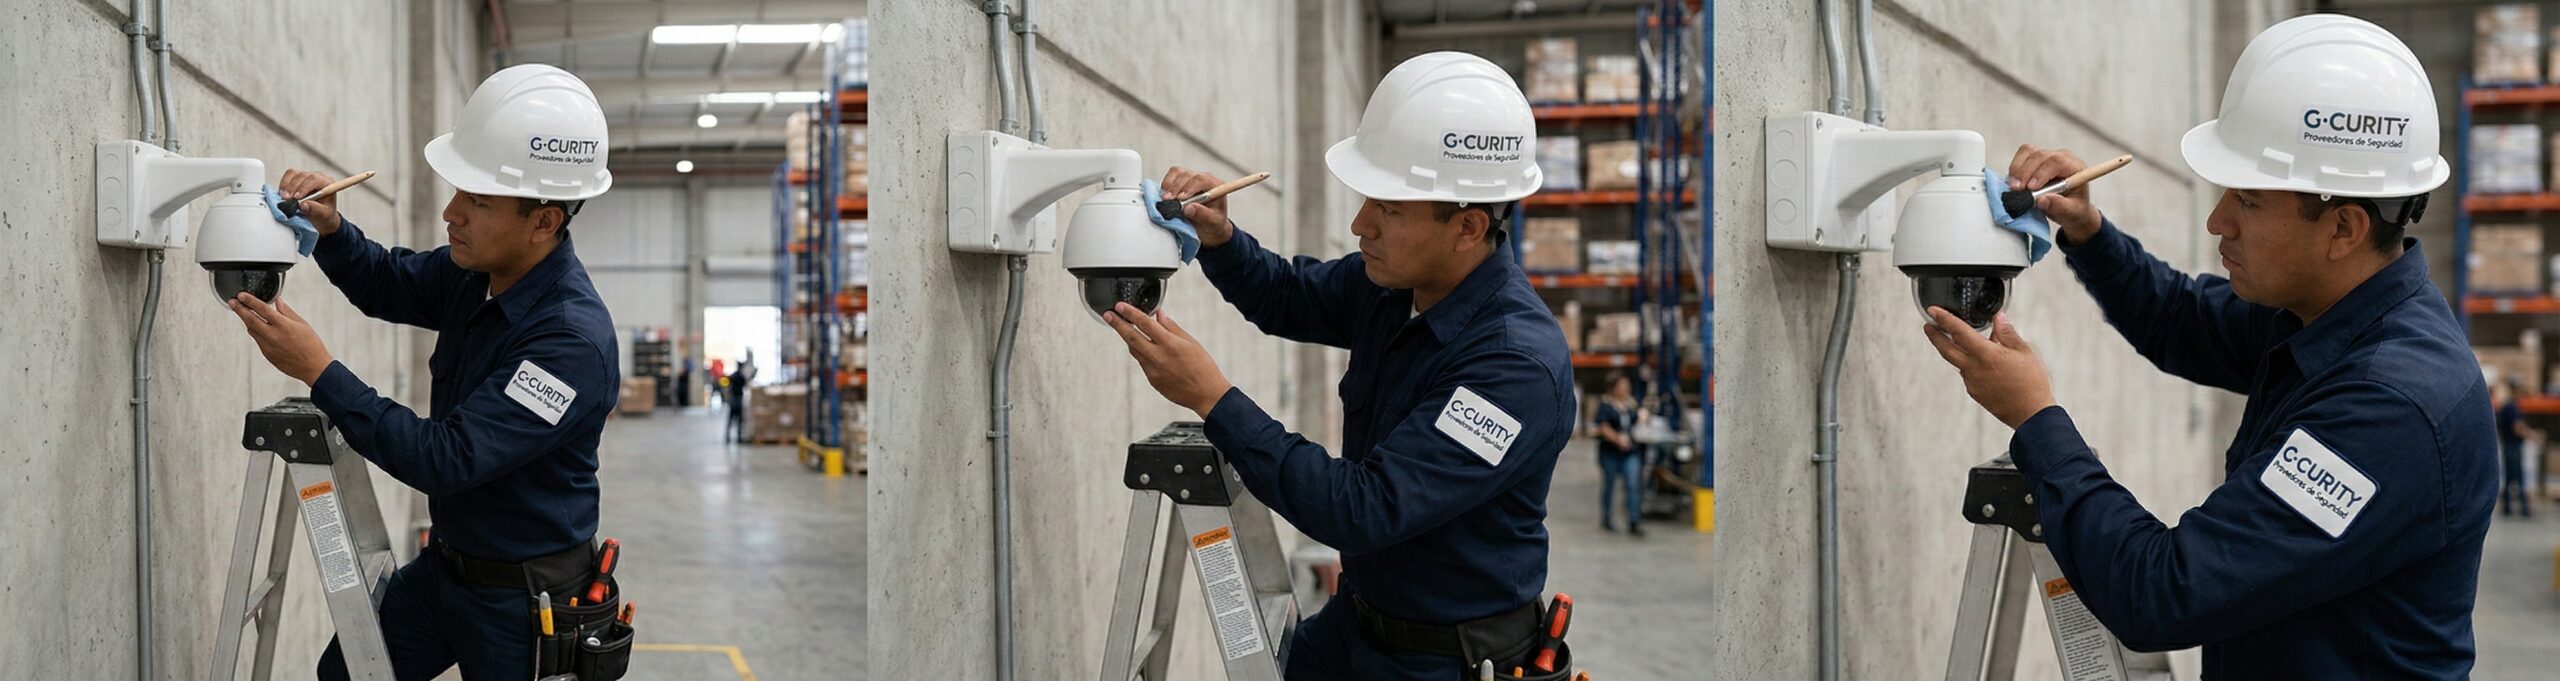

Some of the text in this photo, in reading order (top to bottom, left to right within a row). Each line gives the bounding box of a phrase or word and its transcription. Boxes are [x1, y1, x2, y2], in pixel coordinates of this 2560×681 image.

[2303, 132, 2403, 149] Proveedores de Seguridad
[1485, 153, 1492, 161] de
[2306, 486, 2316, 496] de
